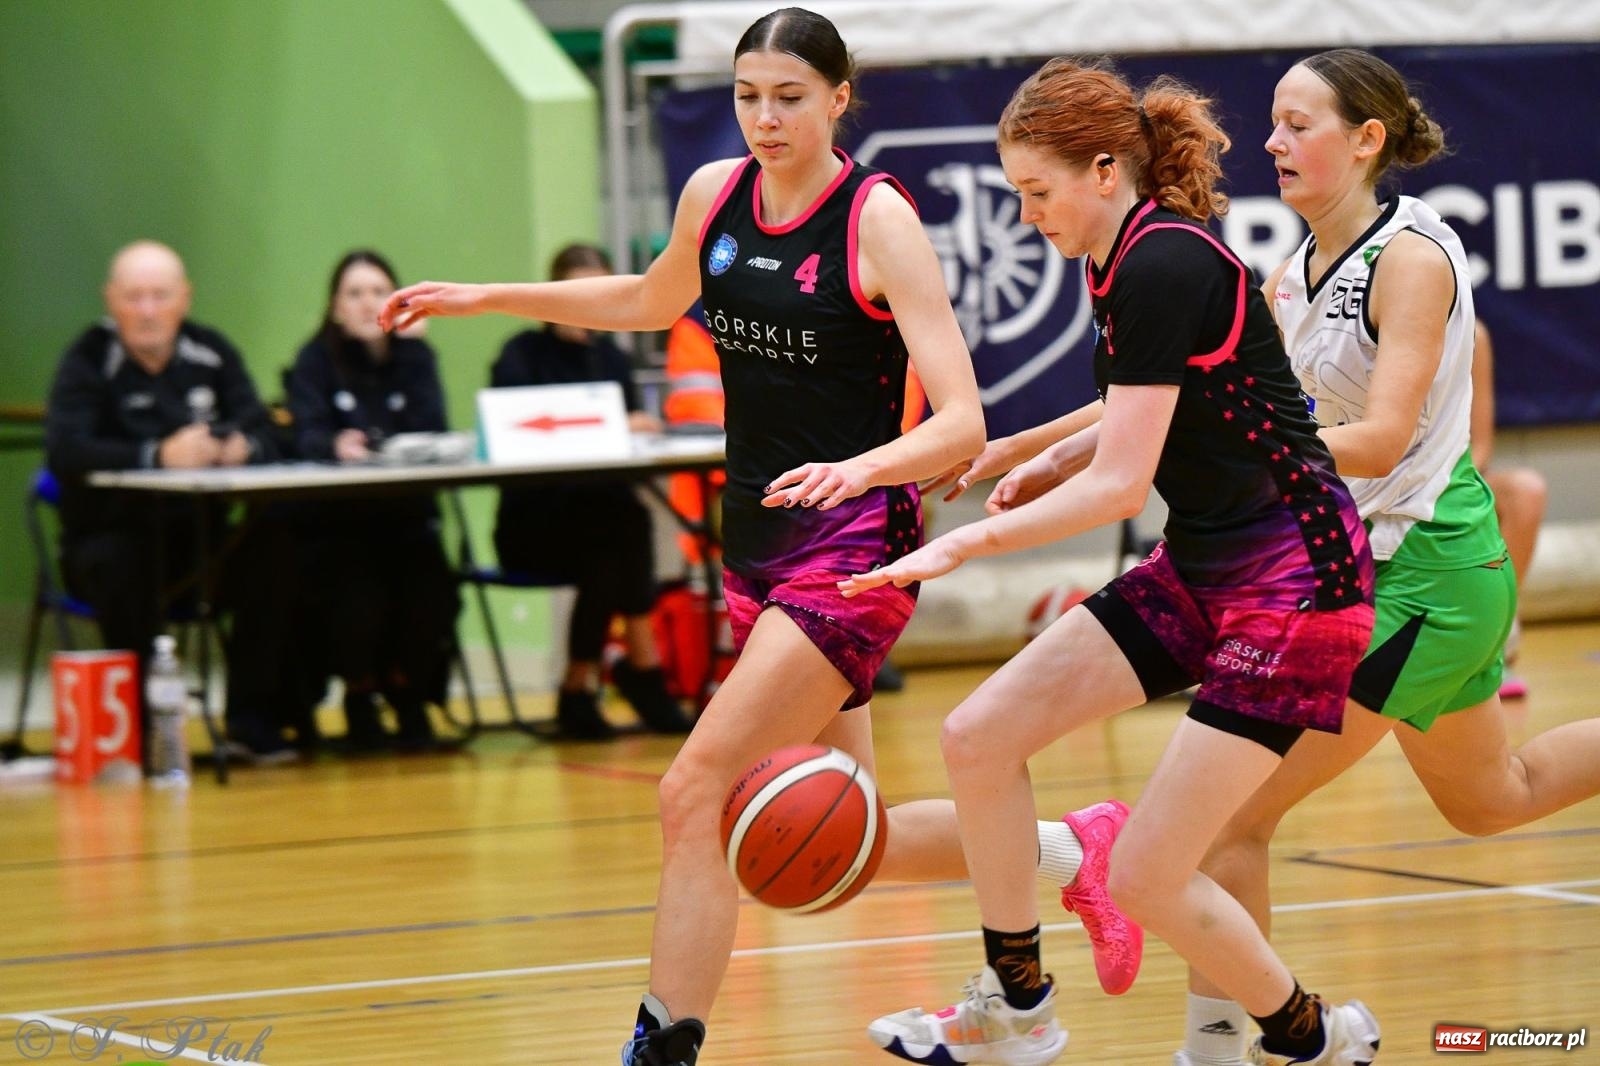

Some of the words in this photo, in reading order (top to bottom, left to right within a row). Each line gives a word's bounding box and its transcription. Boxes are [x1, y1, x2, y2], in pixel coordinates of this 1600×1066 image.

[793, 253, 821, 294] 4
[1222, 179, 1600, 291] RCIB
[96, 665, 132, 754] 5
